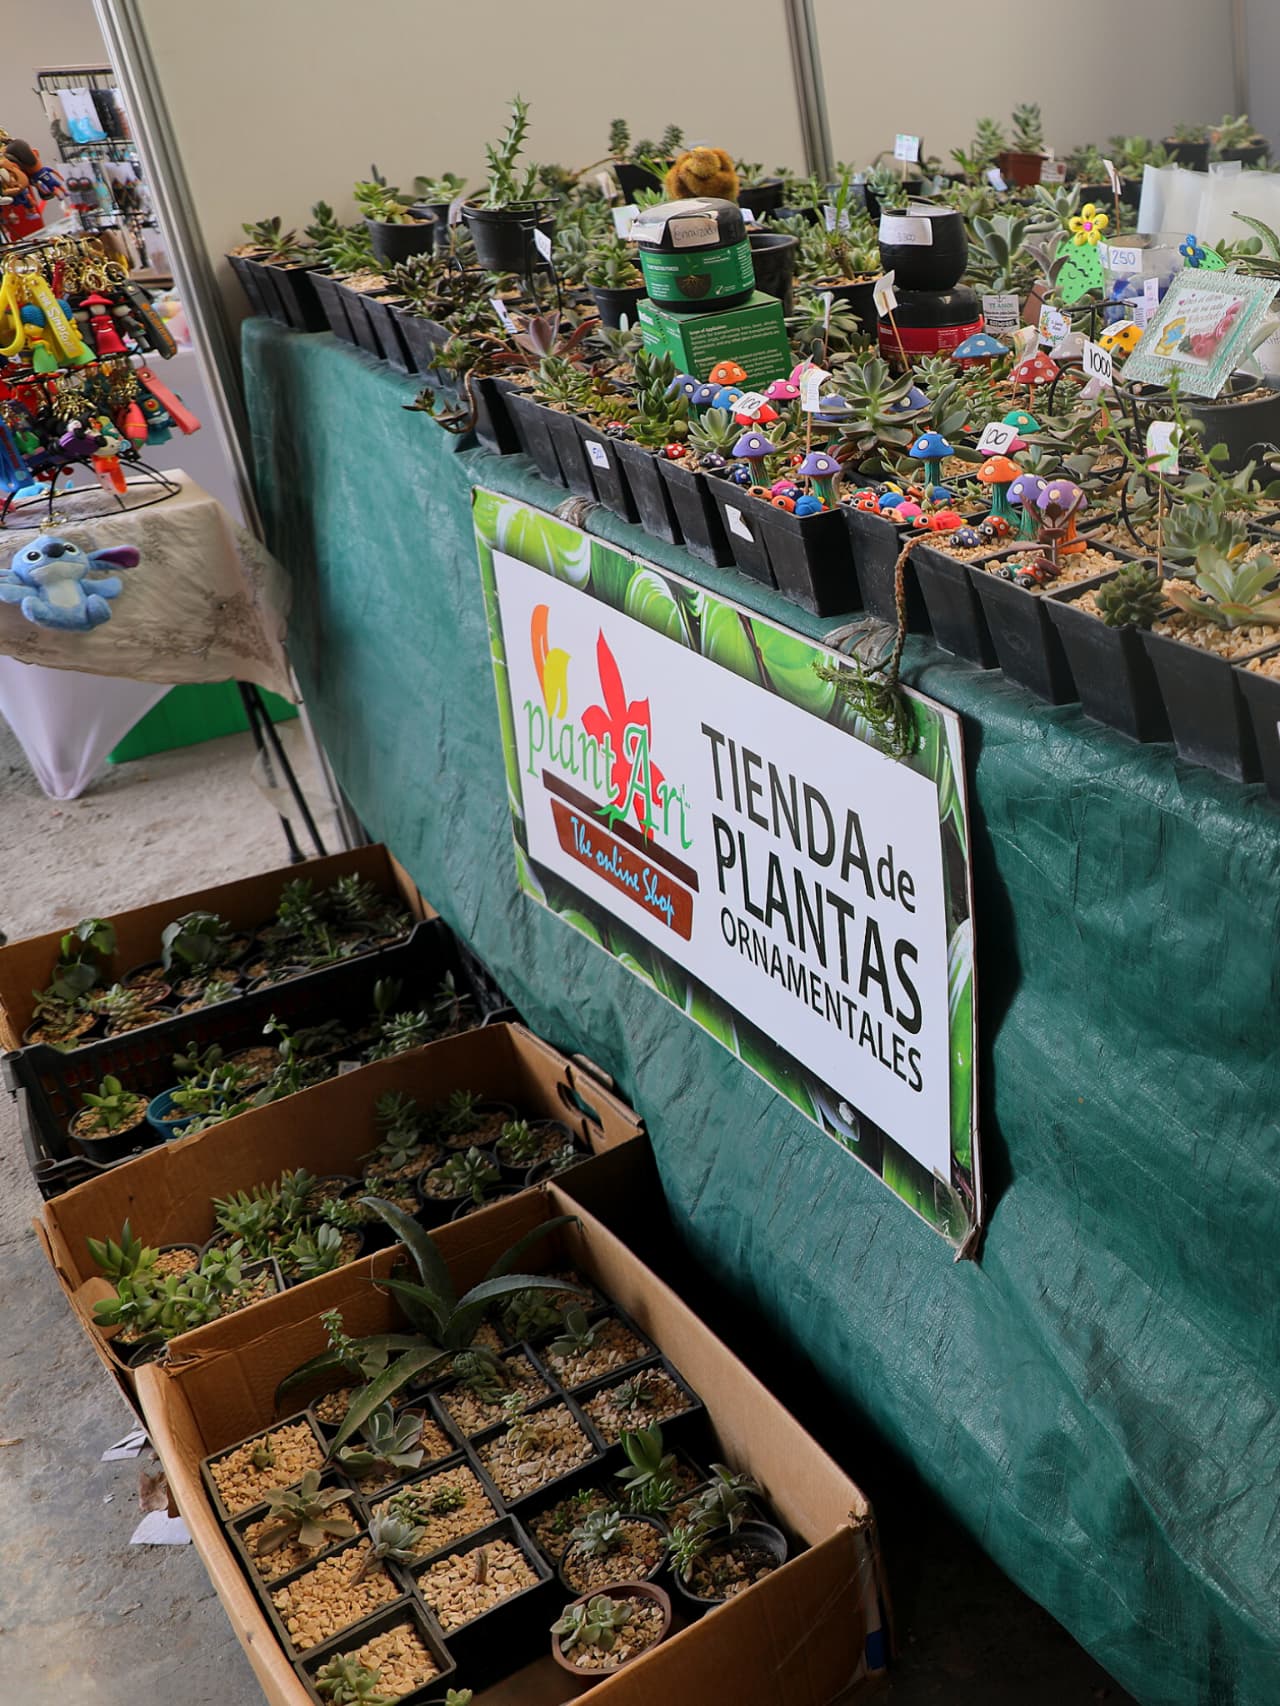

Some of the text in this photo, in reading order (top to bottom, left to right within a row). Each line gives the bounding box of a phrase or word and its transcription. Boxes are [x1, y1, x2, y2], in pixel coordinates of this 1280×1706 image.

[1112, 250, 1136, 266] 250
[1090, 349, 1111, 378] 1000
[570, 816, 676, 927] The online Shop
[701, 721, 917, 914] TIENDA de
[711, 812, 923, 1035] PLANTAS
[720, 906, 924, 1093] ORNAMENTALES
